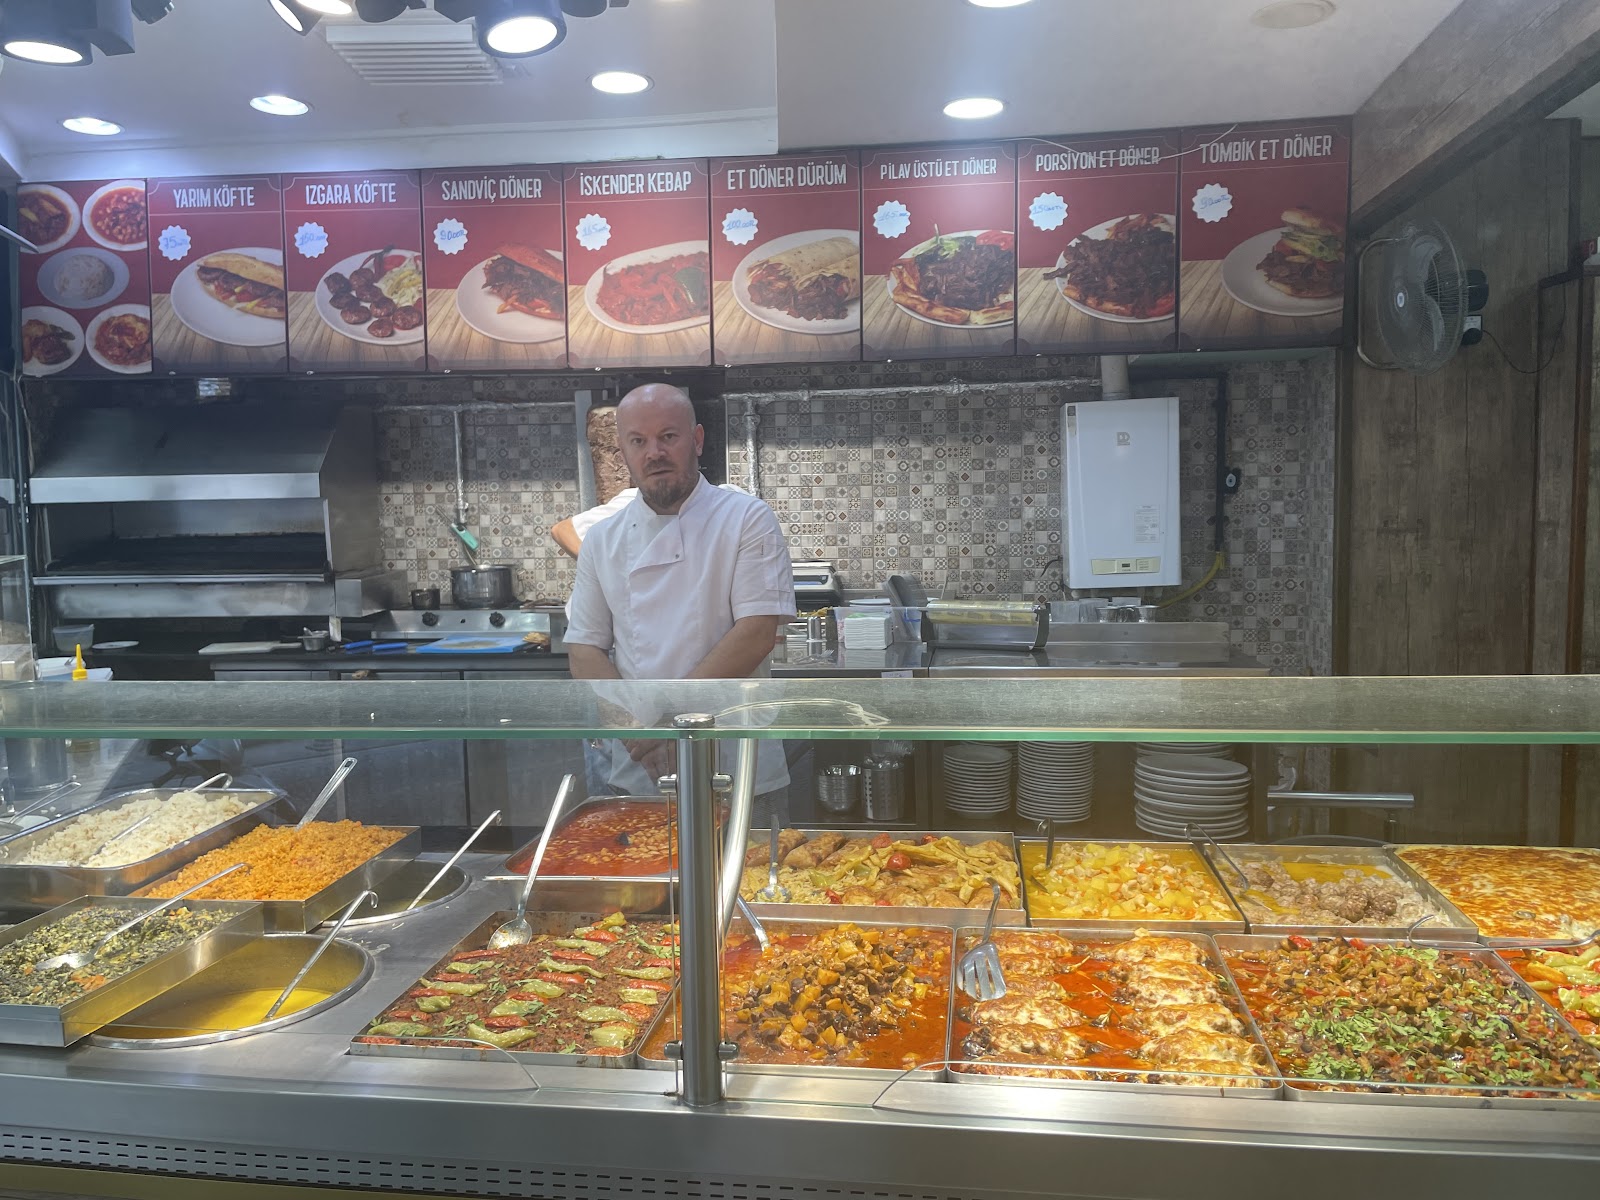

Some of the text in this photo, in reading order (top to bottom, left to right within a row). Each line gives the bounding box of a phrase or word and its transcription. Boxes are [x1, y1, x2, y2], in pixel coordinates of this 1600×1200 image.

[1035, 145, 1160, 172] PORSİYON ET DÖNER
[1201, 135, 1332, 164] TOMBİK ET DÖNER
[727, 161, 847, 190] ET DÖNER DÜRÜM
[880, 158, 997, 180] PİLAV ÜSTÜ ET DÖNER
[305, 180, 397, 205] IZGARA KÖFTE
[441, 176, 542, 203] SANDVİÇ DÖNER
[580, 170, 692, 196] İSKENDER KEBAP
[173, 184, 255, 209] YARIM KÖFTE
